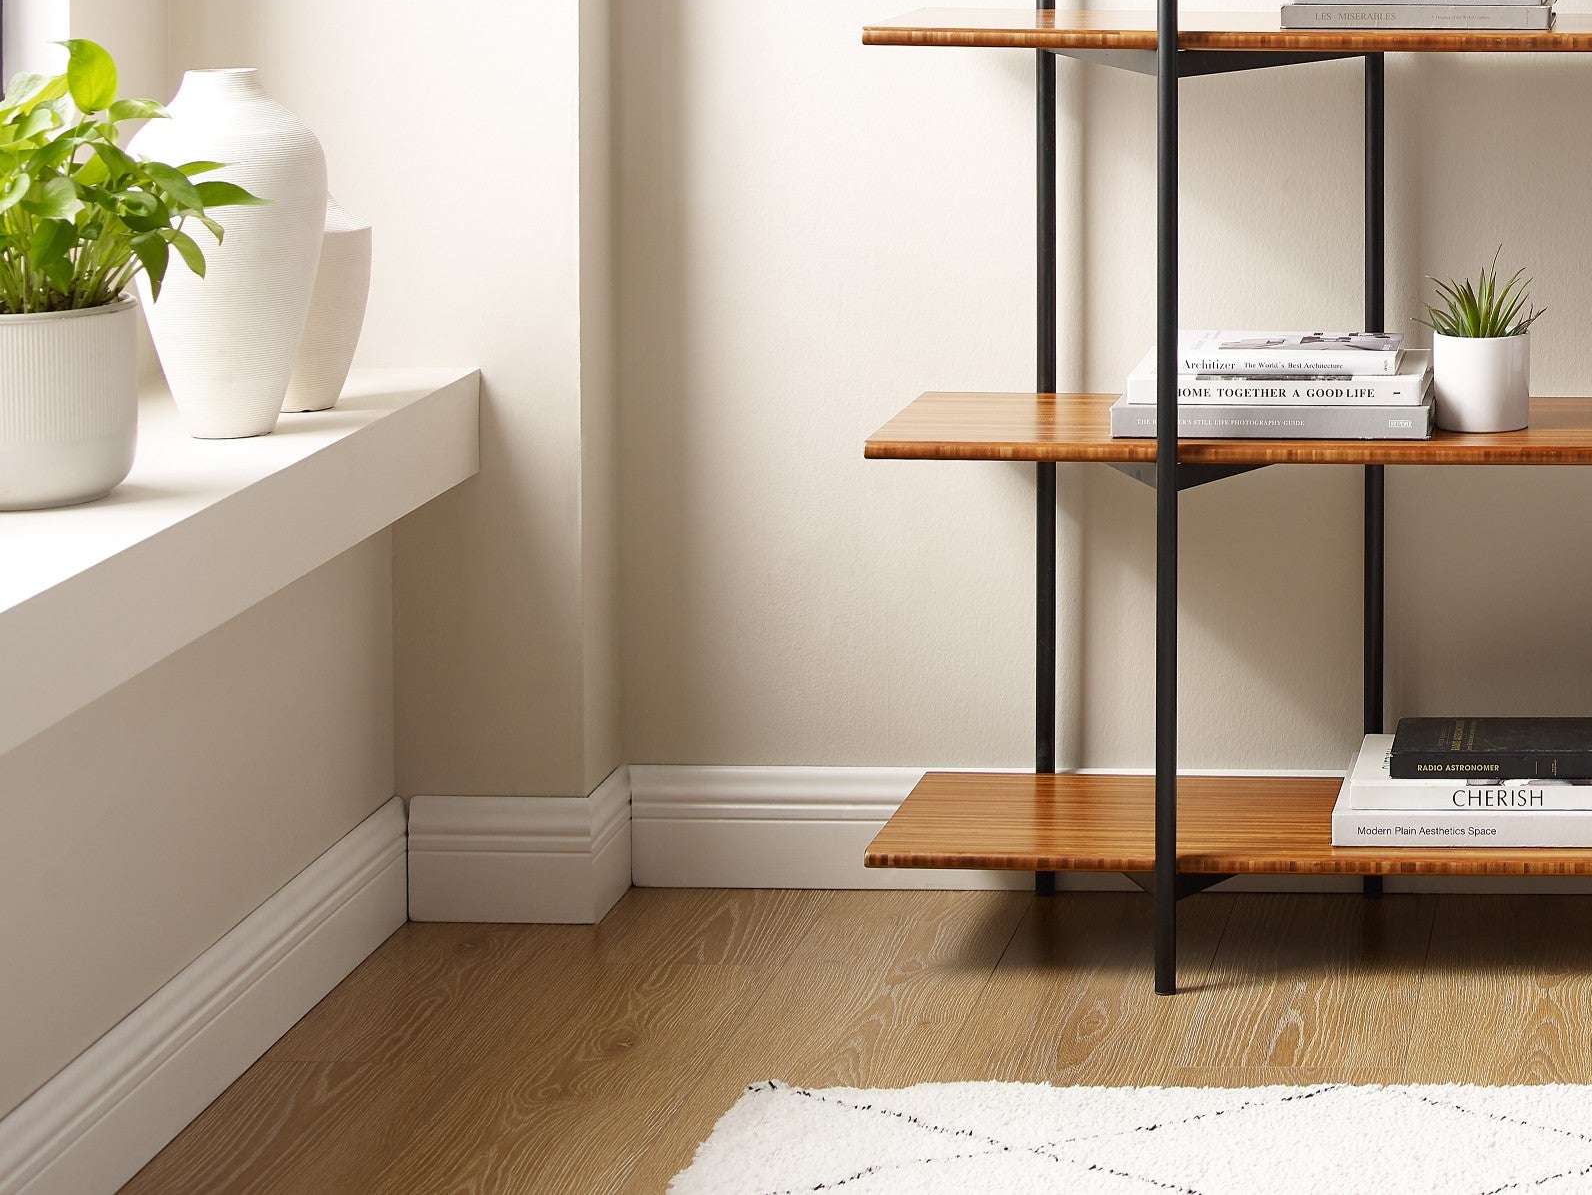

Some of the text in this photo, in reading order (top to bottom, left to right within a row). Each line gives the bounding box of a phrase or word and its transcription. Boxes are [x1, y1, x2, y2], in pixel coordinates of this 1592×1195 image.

[1314, 12, 1397, 21] LES MISERABLES
[1182, 359, 1237, 370] Architizer
[1216, 388, 1287, 398] TOGETHER
[1292, 388, 1301, 398] A
[1306, 388, 1344, 398] GOOD
[1346, 388, 1375, 398] LIFE
[1416, 764, 1500, 772] RADIO ASTRONOMER
[1452, 789, 1544, 807] CHERISH
[1356, 826, 1497, 838] Modern Plain Aesthetics Space
